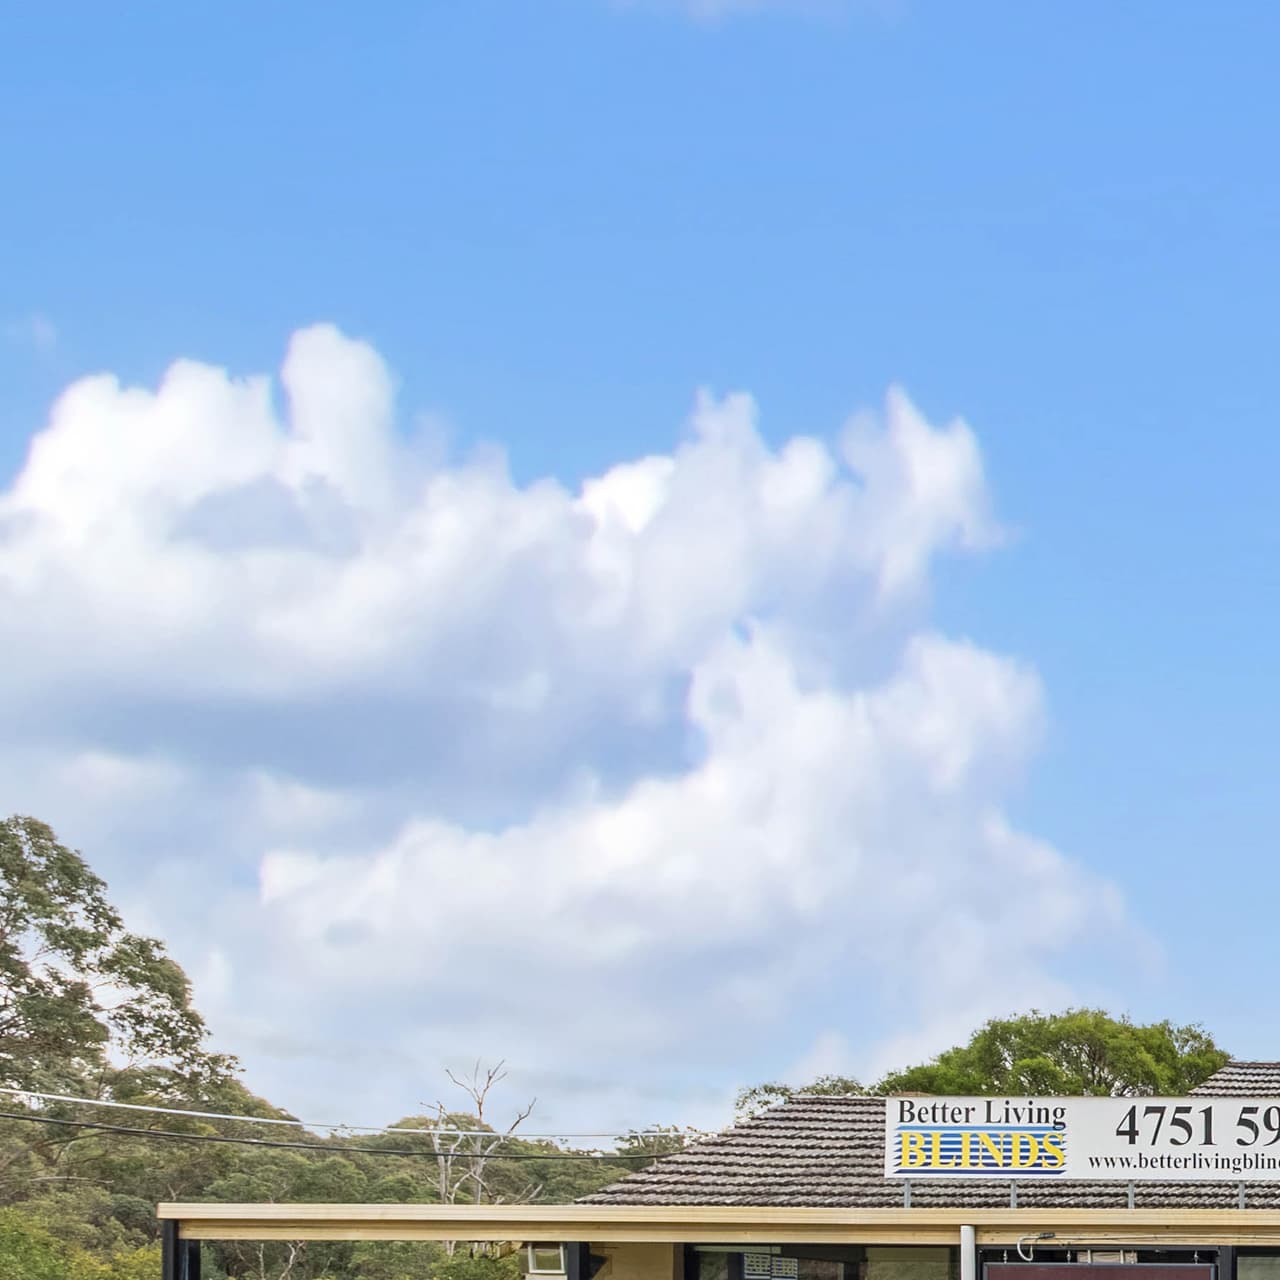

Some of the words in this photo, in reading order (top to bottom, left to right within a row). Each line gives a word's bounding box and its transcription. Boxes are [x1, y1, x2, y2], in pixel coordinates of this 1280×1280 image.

[898, 1100, 976, 1124] Better
[984, 1100, 1066, 1130] Living
[1115, 1105, 1216, 1147] 4751
[898, 1132, 1066, 1169] BLINDS
